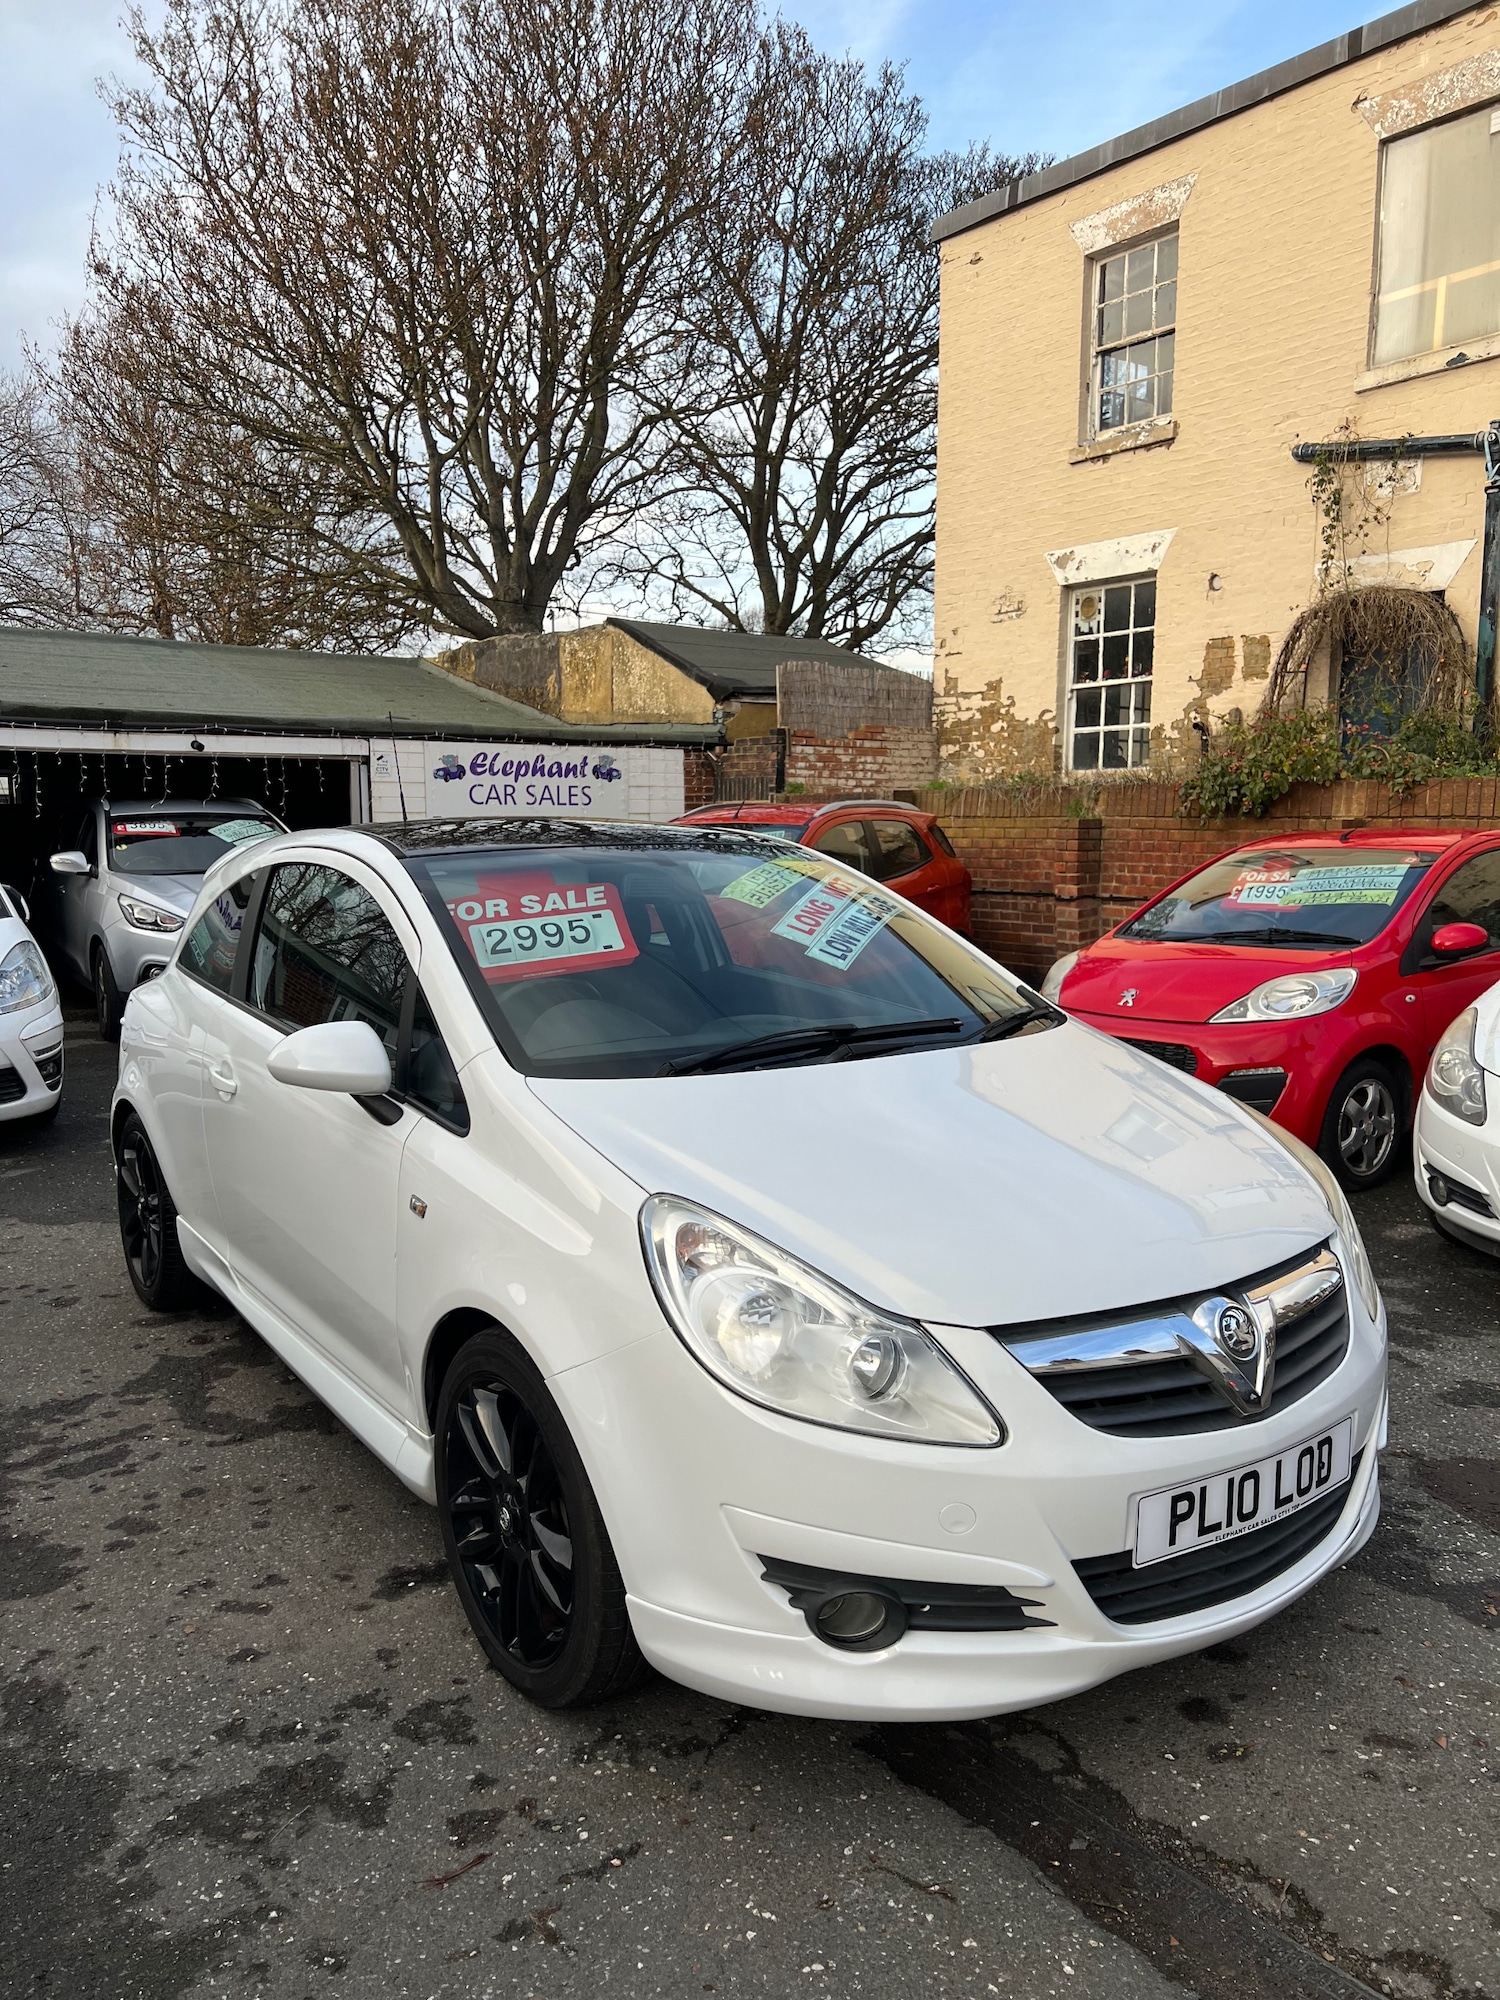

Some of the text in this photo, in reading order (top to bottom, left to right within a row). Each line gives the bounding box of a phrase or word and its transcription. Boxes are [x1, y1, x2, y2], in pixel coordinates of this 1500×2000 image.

[469, 751, 589, 783] Elephant
[469, 783, 592, 806] CAR SALES
[1237, 871, 1269, 881] FOR
[1271, 871, 1297, 881] SA
[520, 886, 608, 914] SALE
[786, 876, 858, 936] LONG MOT
[486, 918, 592, 955] 2995
[819, 895, 898, 961] LOW MILEAGE
[1169, 1435, 1333, 1547] PL10 LOD
[1215, 1526, 1247, 1542] ELEPHANT
[1247, 1522, 1260, 1531] CAR
[1260, 1514, 1277, 1526] SALES
